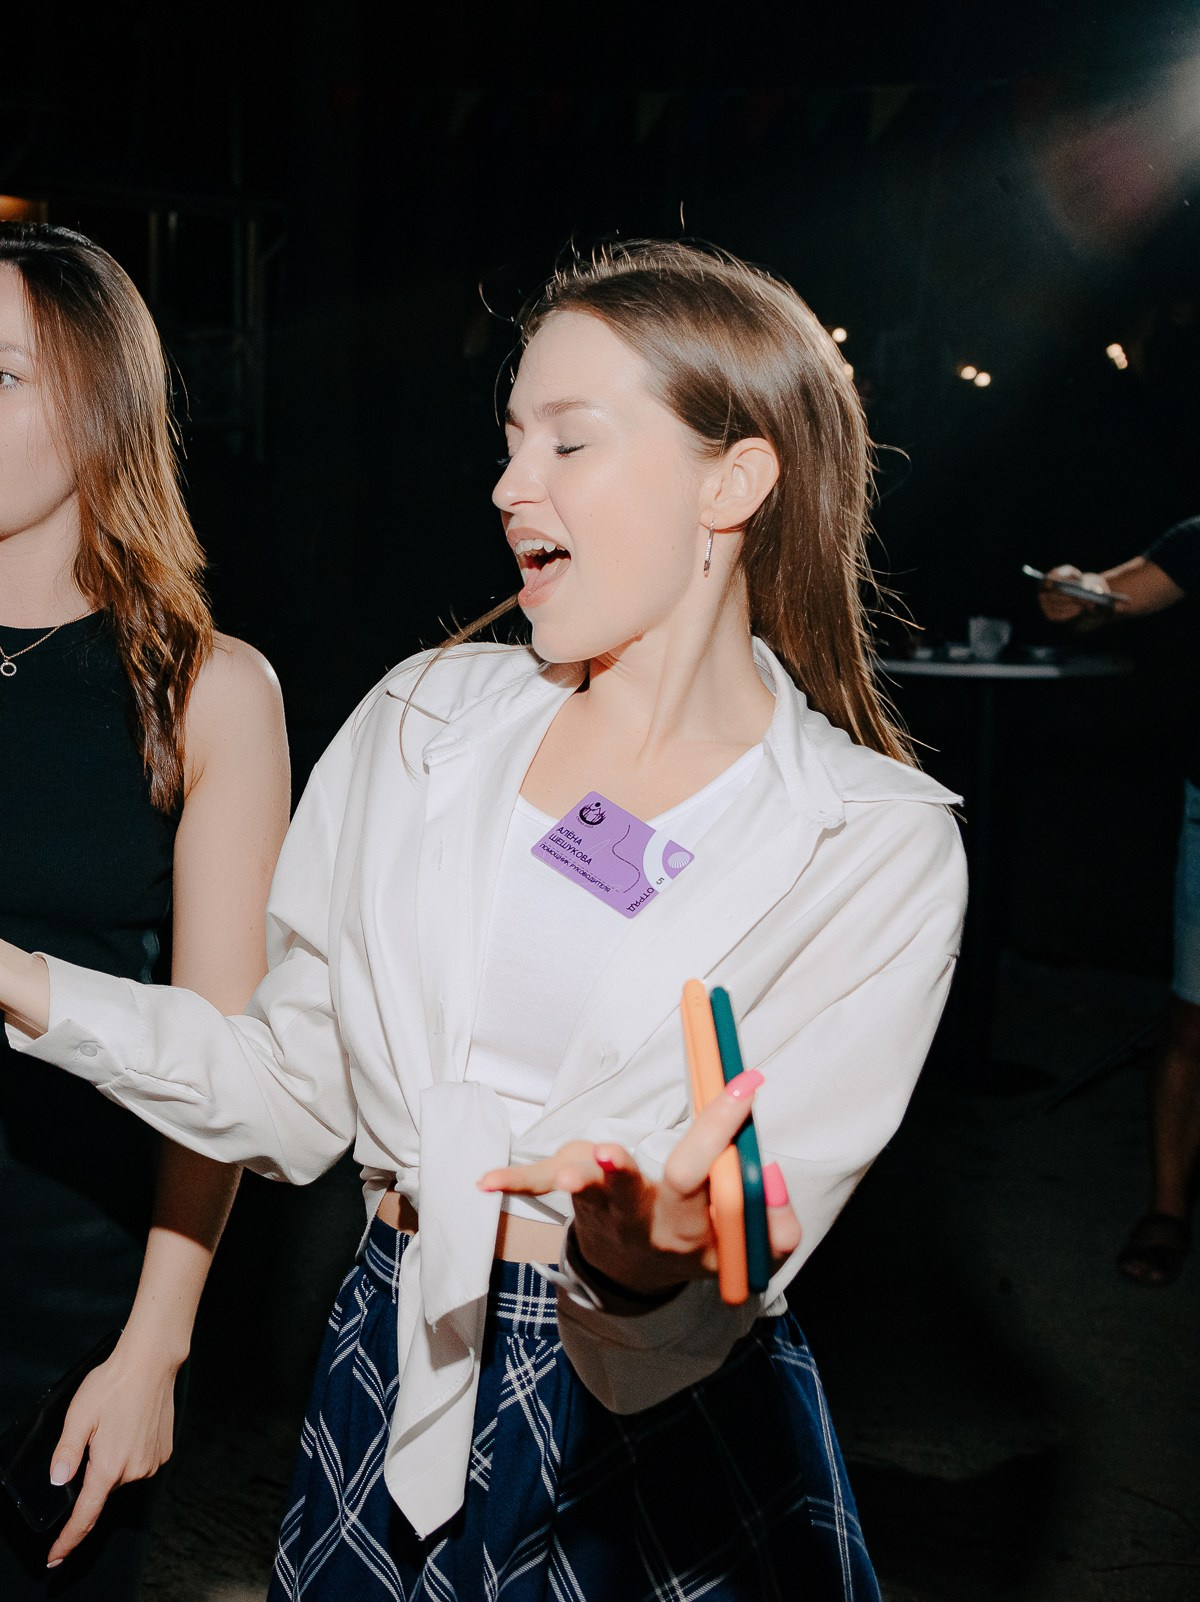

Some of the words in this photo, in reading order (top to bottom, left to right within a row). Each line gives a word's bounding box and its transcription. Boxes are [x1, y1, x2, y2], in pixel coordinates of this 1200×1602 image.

[556, 825, 583, 846] АЛЁНА
[548, 833, 593, 866] ШЕШУКОВА
[539, 842, 569, 866] ПОМОЩНИК
[570, 863, 611, 893] РУКОВОДИТЕЛЯ
[656, 877, 665, 885] 5
[626, 887, 655, 912] ОТРЯД
